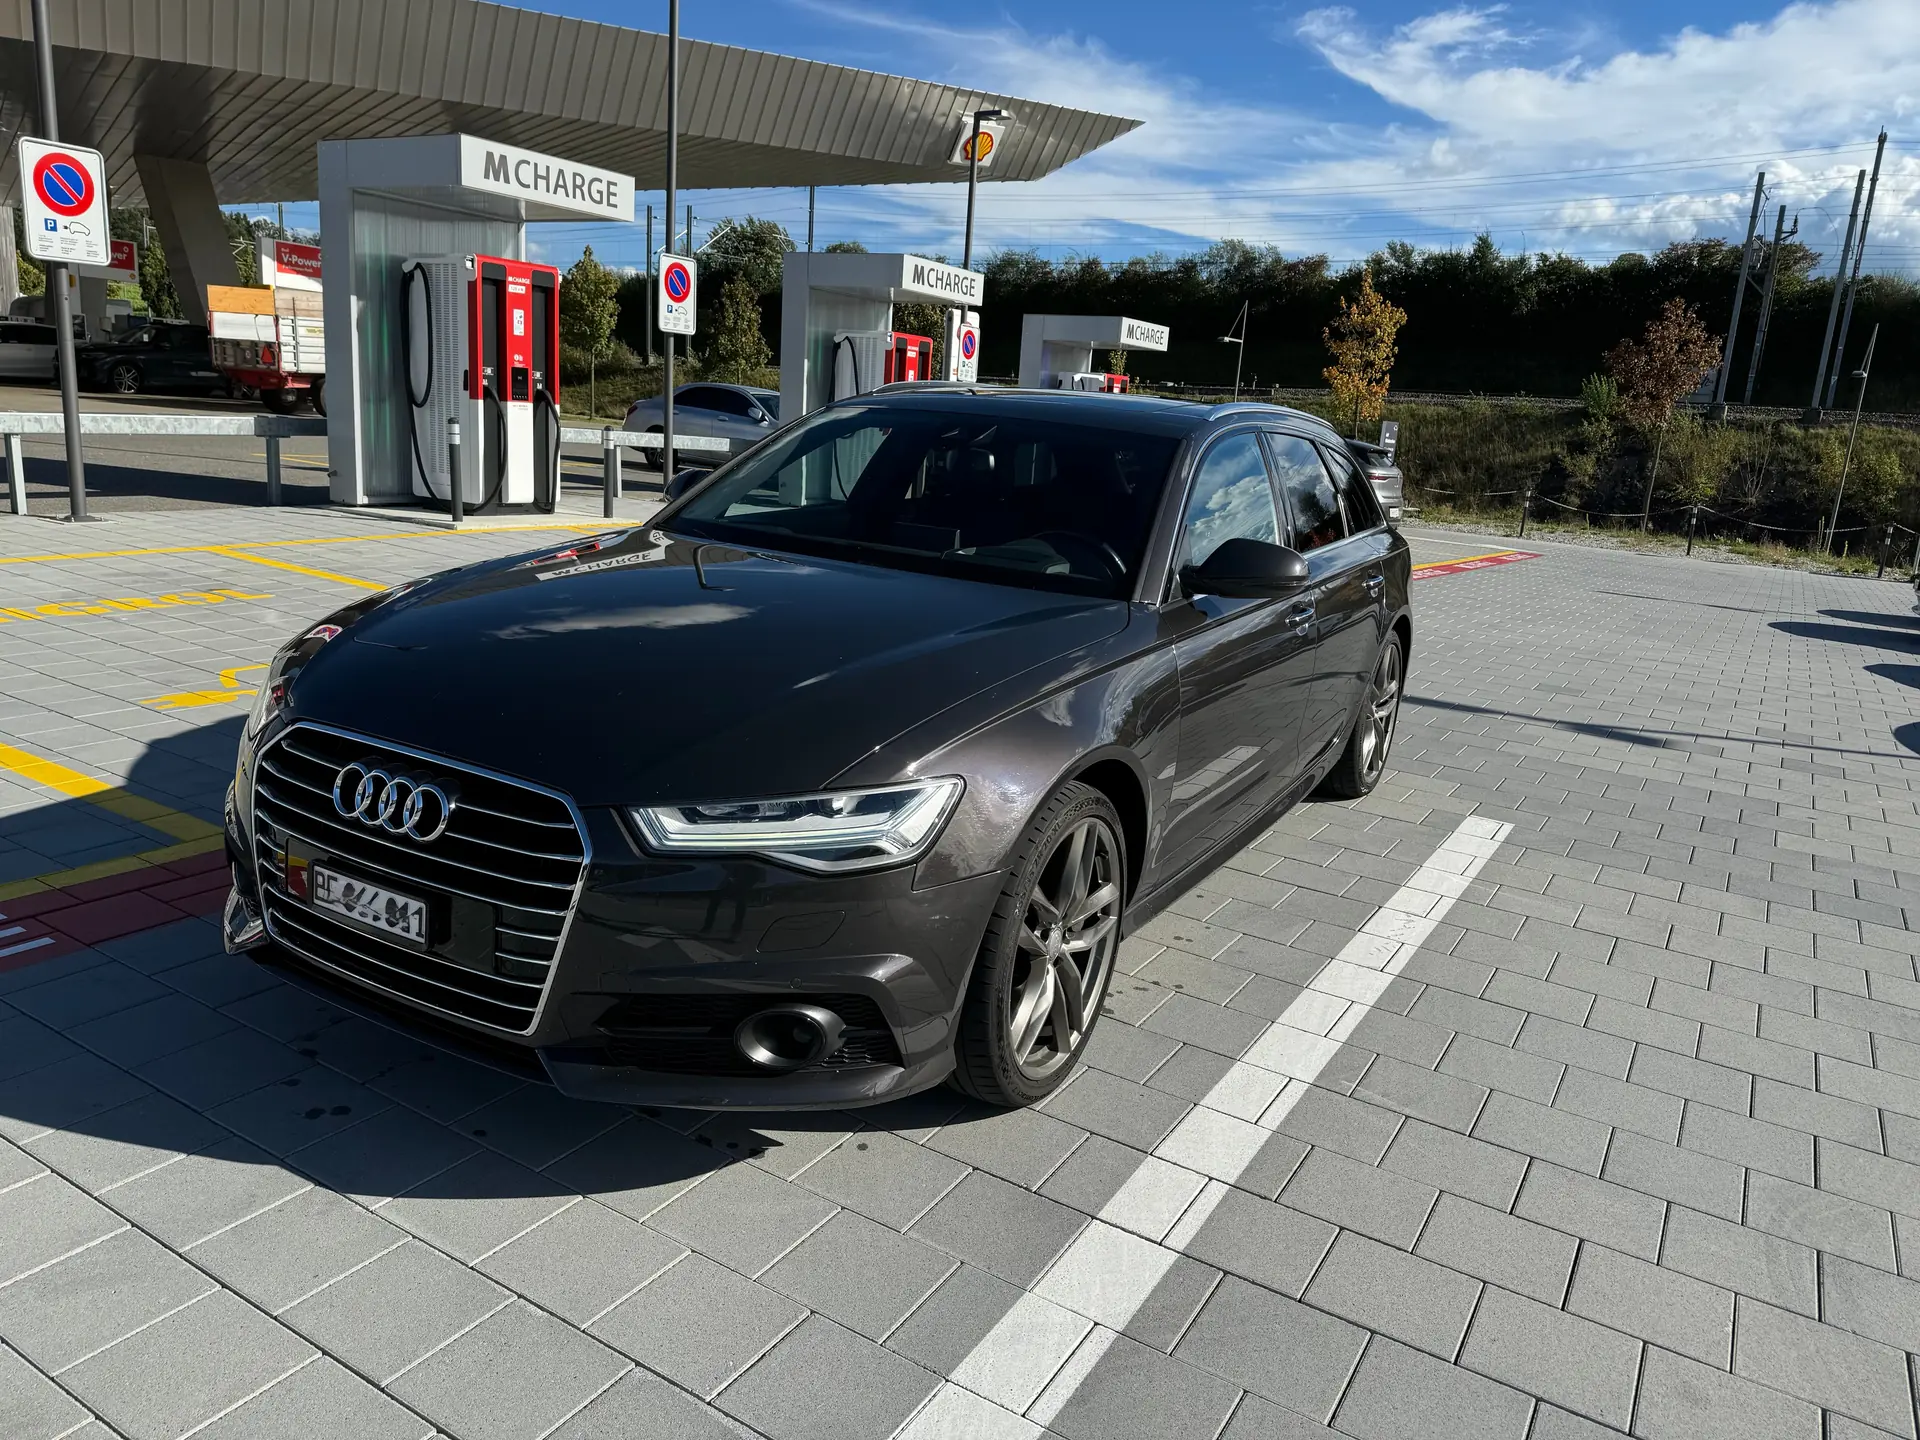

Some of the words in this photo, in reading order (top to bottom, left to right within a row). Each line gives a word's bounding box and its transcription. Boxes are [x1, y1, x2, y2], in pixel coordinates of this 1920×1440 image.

[484, 150, 618, 209] MCHARGE
[282, 252, 322, 268] V-Power
[911, 264, 976, 298] MCHARGE
[1126, 323, 1165, 346] MCHARGE
[0, 588, 275, 623] IGROL
